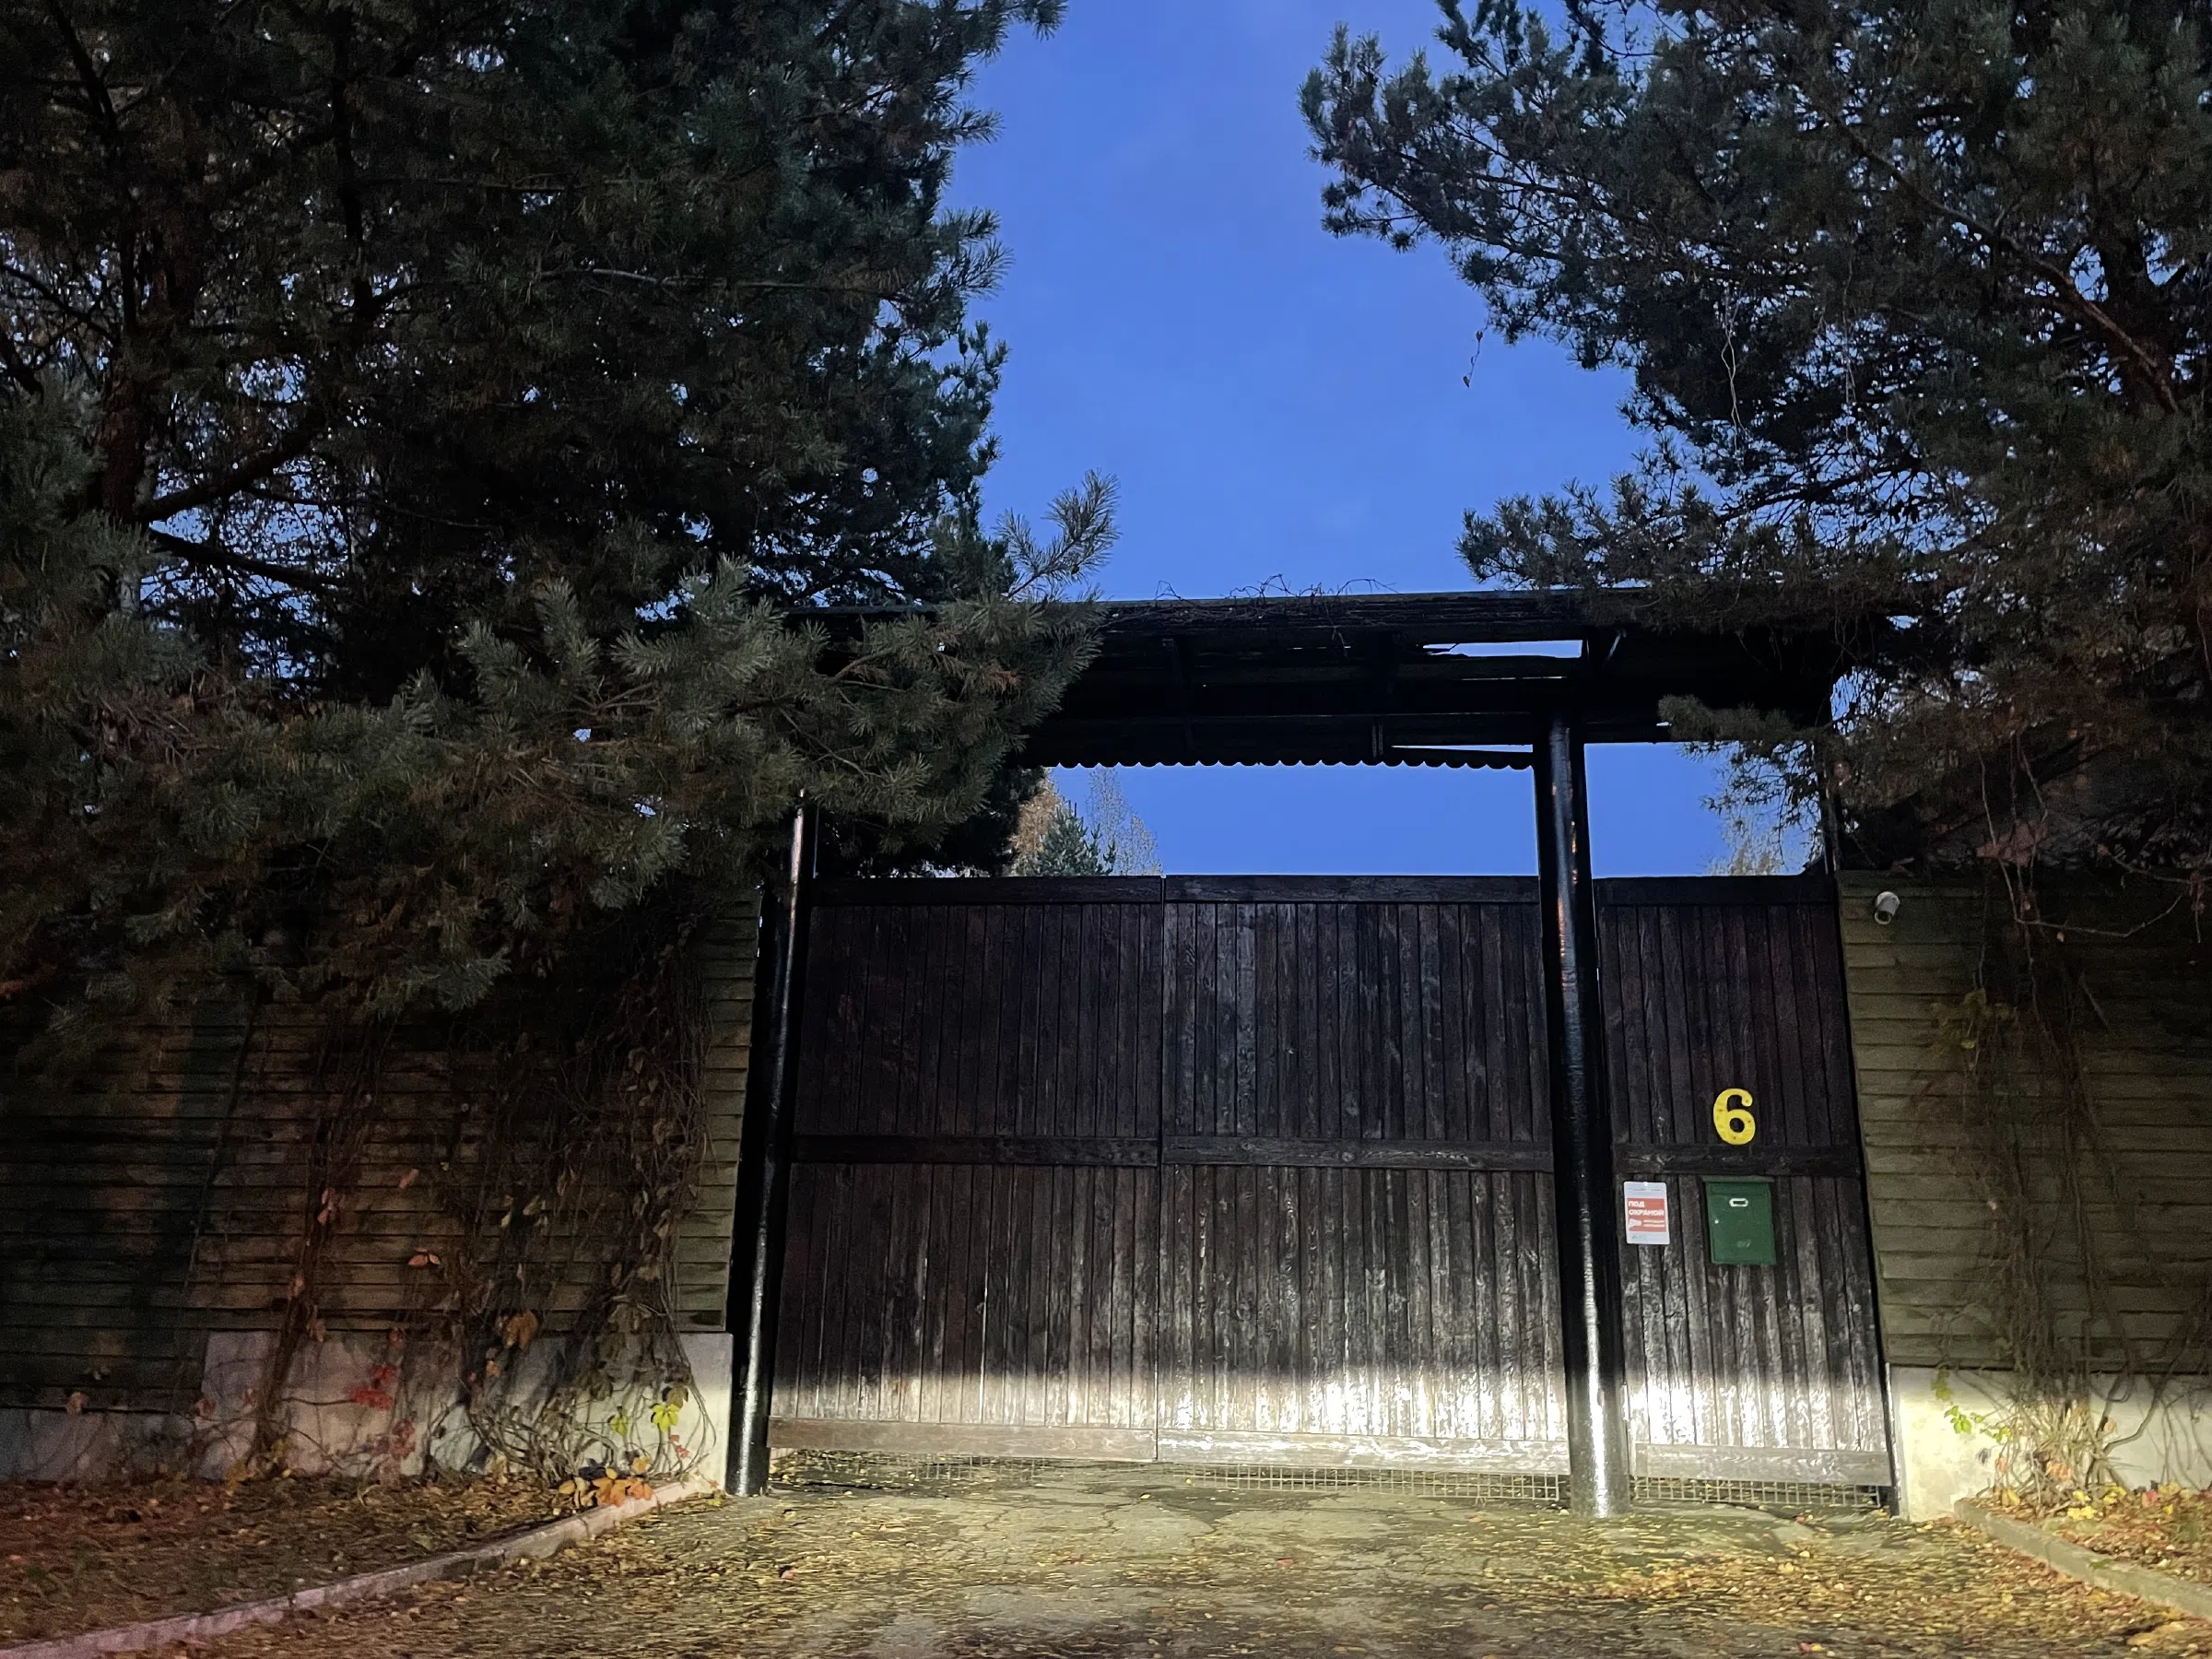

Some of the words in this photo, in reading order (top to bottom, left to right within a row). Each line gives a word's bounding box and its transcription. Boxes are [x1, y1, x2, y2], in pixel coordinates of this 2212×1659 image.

[1712, 1088, 1756, 1146] 6
[1628, 1200, 1645, 1208] ПОД
[1628, 1208, 1665, 1217] ОХРАНОЙ
